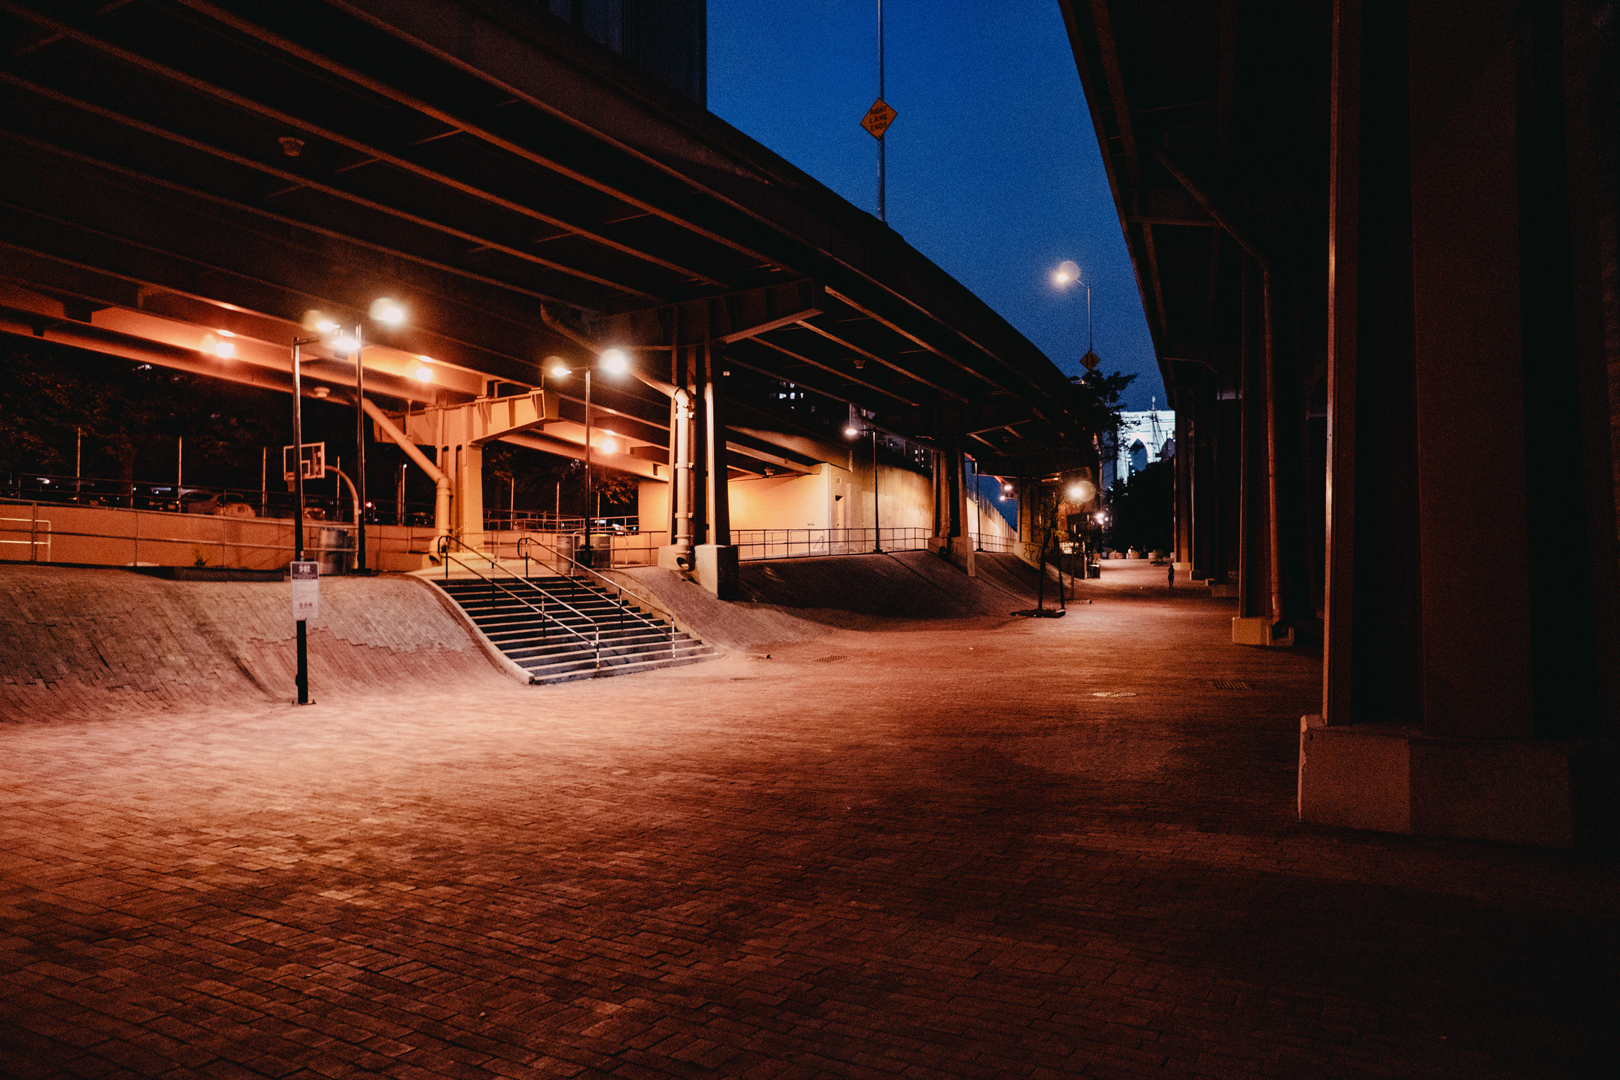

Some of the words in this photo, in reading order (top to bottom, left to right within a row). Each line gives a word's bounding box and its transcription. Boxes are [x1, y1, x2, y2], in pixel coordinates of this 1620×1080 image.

[870, 106, 887, 115] RIGHT
[869, 113, 888, 124] LANE
[870, 122, 888, 131] ENDS
